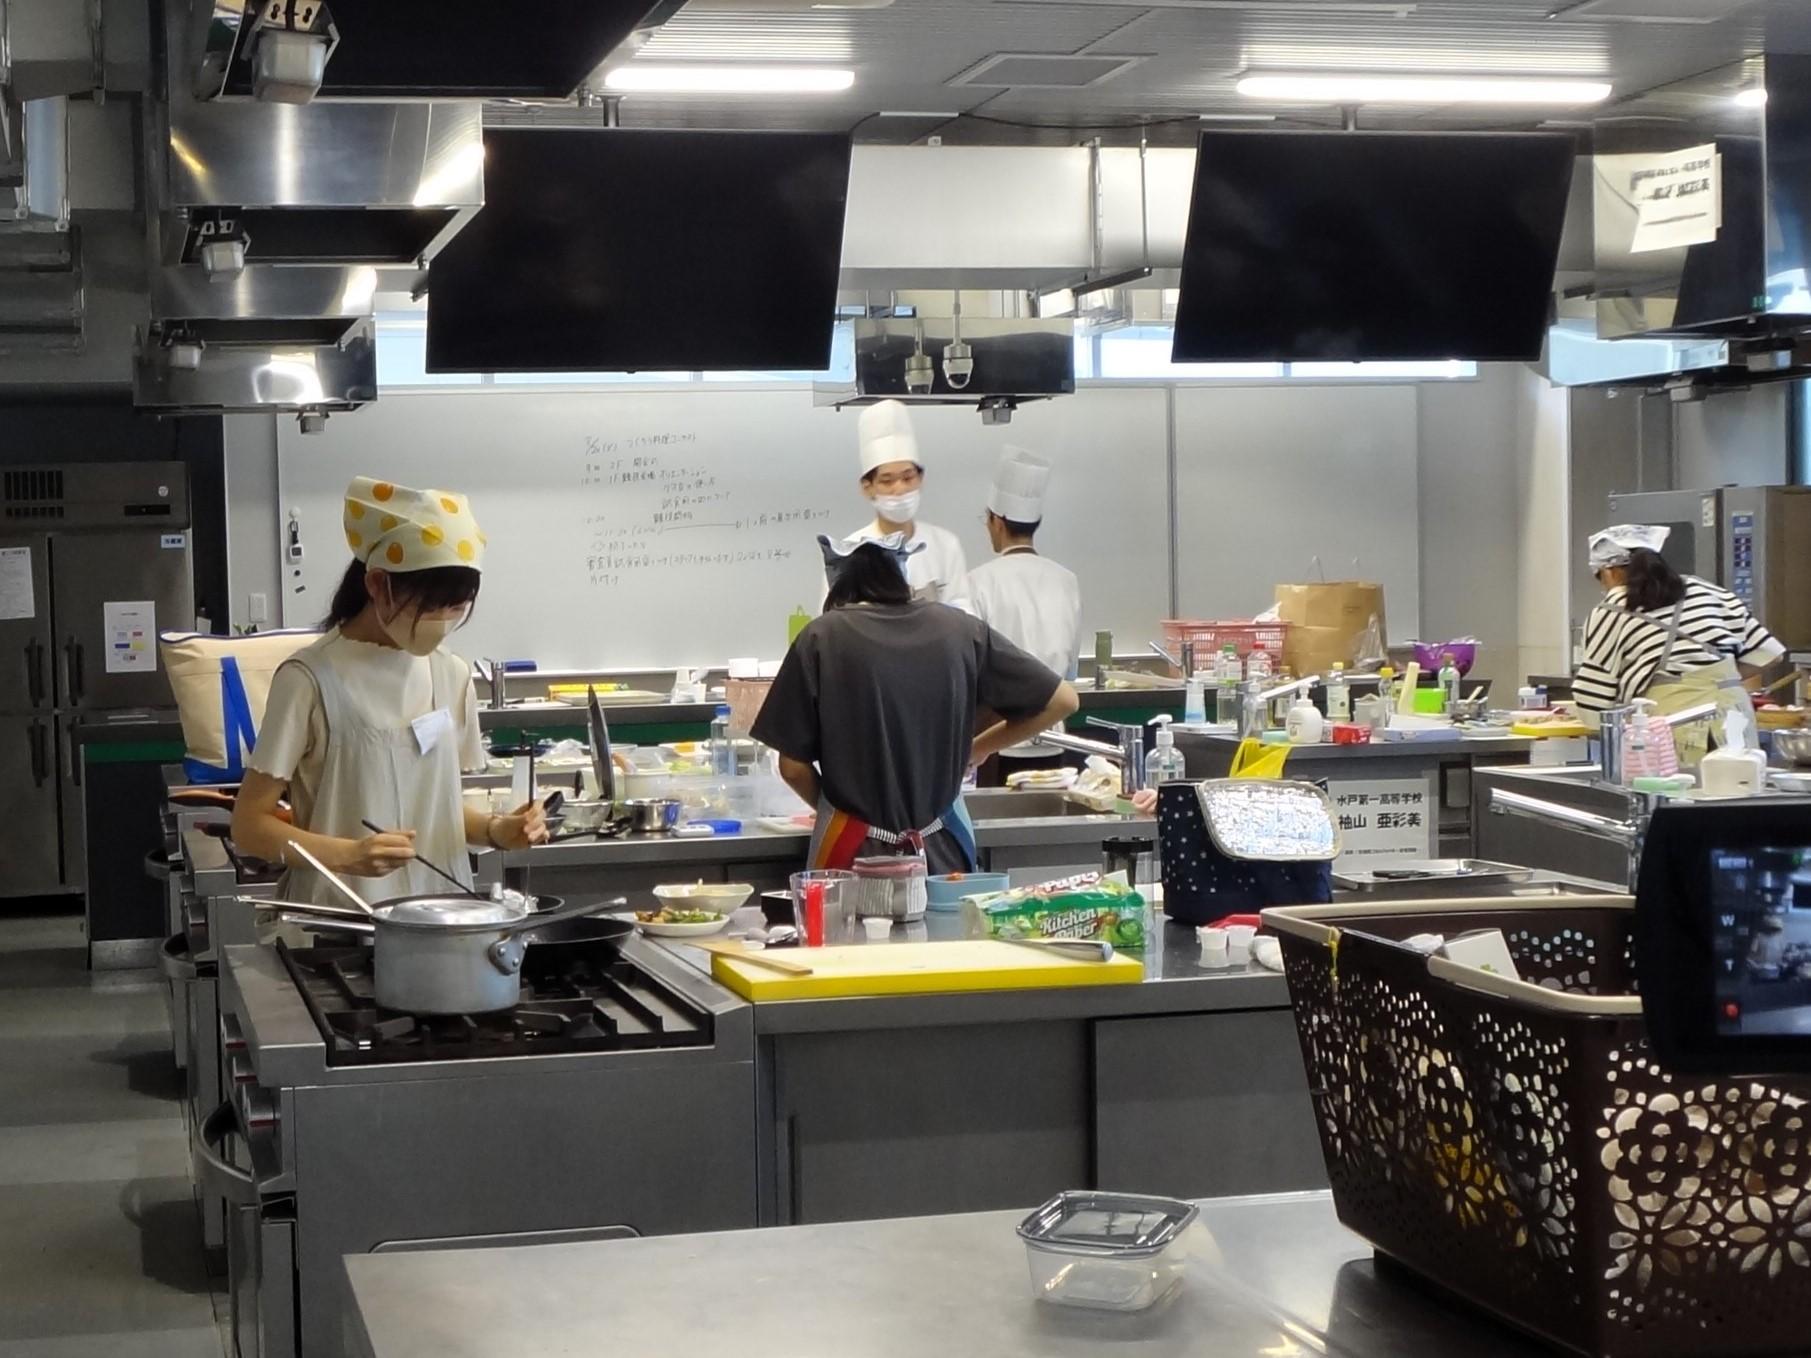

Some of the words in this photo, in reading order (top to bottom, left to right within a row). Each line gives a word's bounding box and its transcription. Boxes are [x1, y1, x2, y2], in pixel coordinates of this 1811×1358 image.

[1337, 792, 1423, 807] 水戸第一高等学校
[1040, 908, 1097, 935] Kitchen
[1721, 914, 1735, 927] W
